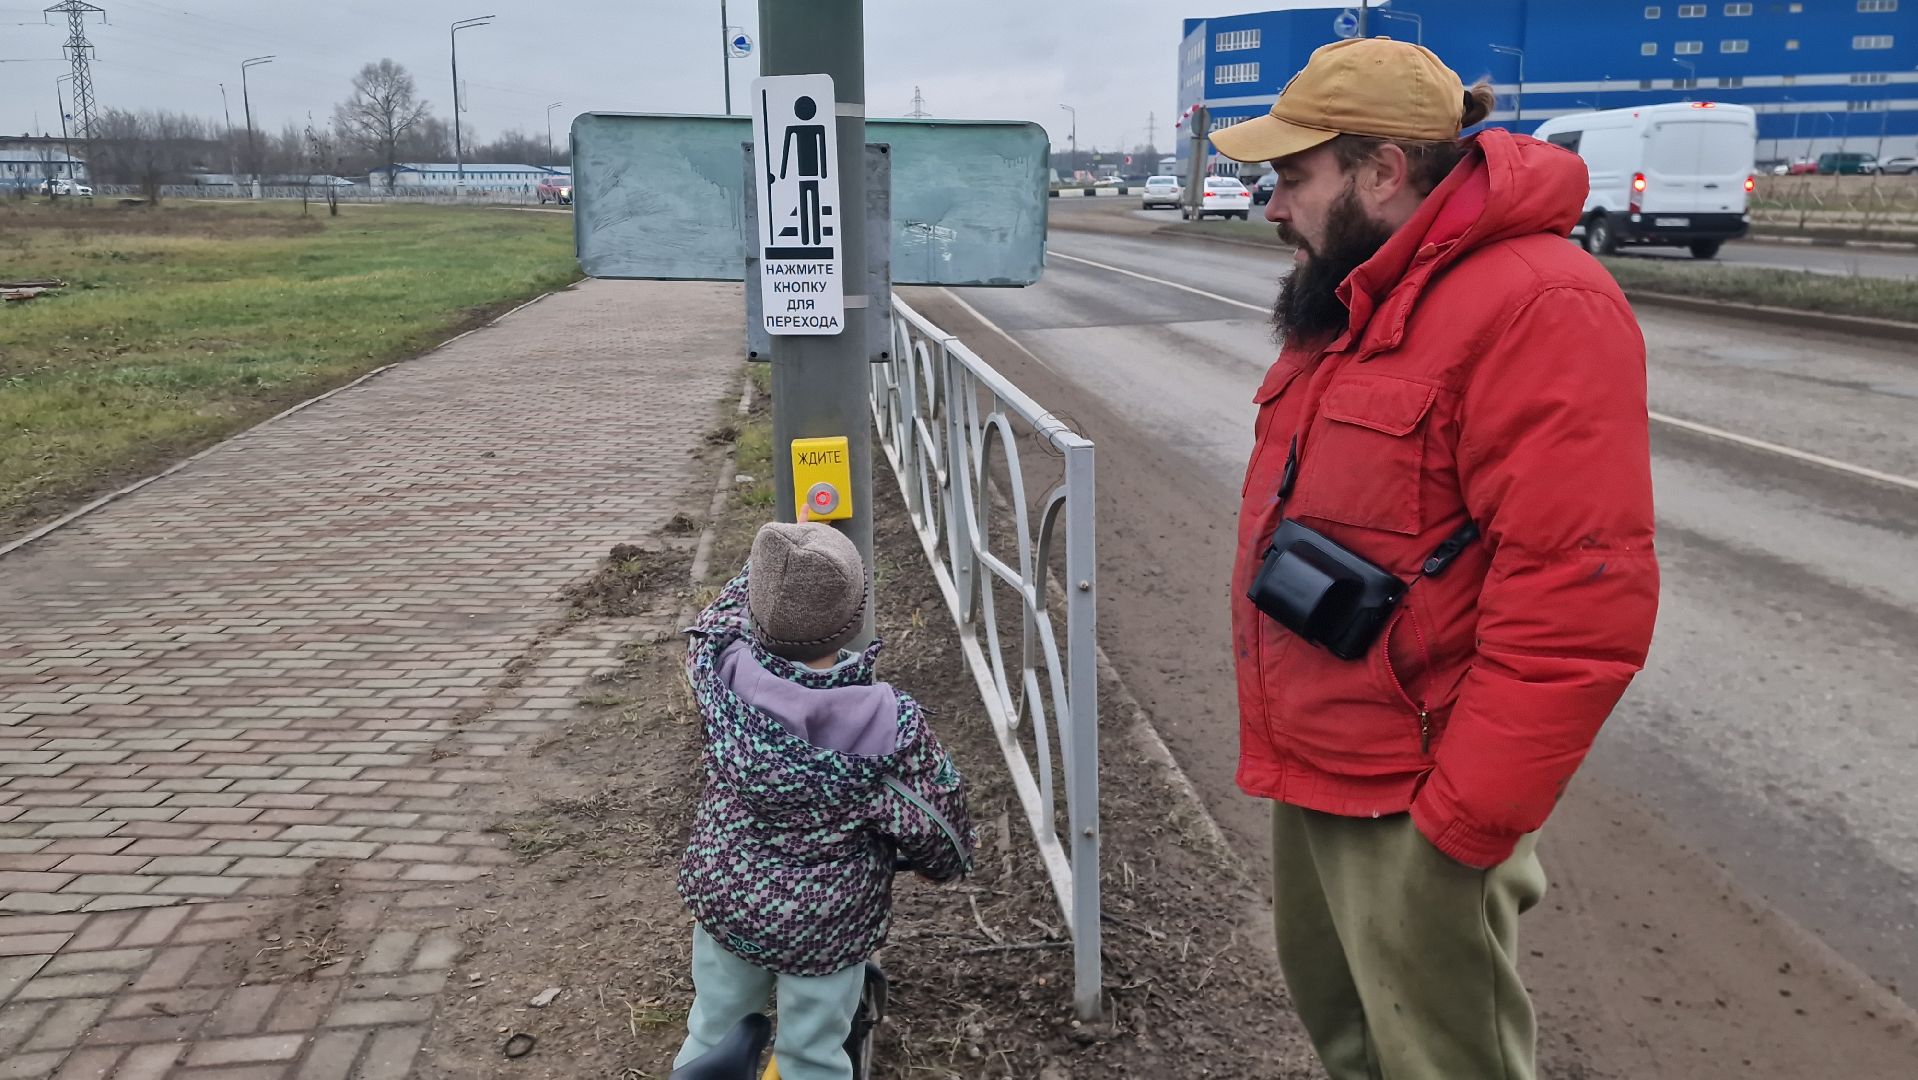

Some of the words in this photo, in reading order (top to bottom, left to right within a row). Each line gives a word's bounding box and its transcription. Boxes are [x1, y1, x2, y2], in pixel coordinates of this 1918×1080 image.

[766, 263, 834, 275] НАЖМИТЕ
[774, 281, 827, 293] КНОПКУ
[786, 299, 815, 311] ДЛЯ
[766, 315, 838, 328] ПЕРЕХОДА
[798, 451, 842, 466] ЖДИТЕ
